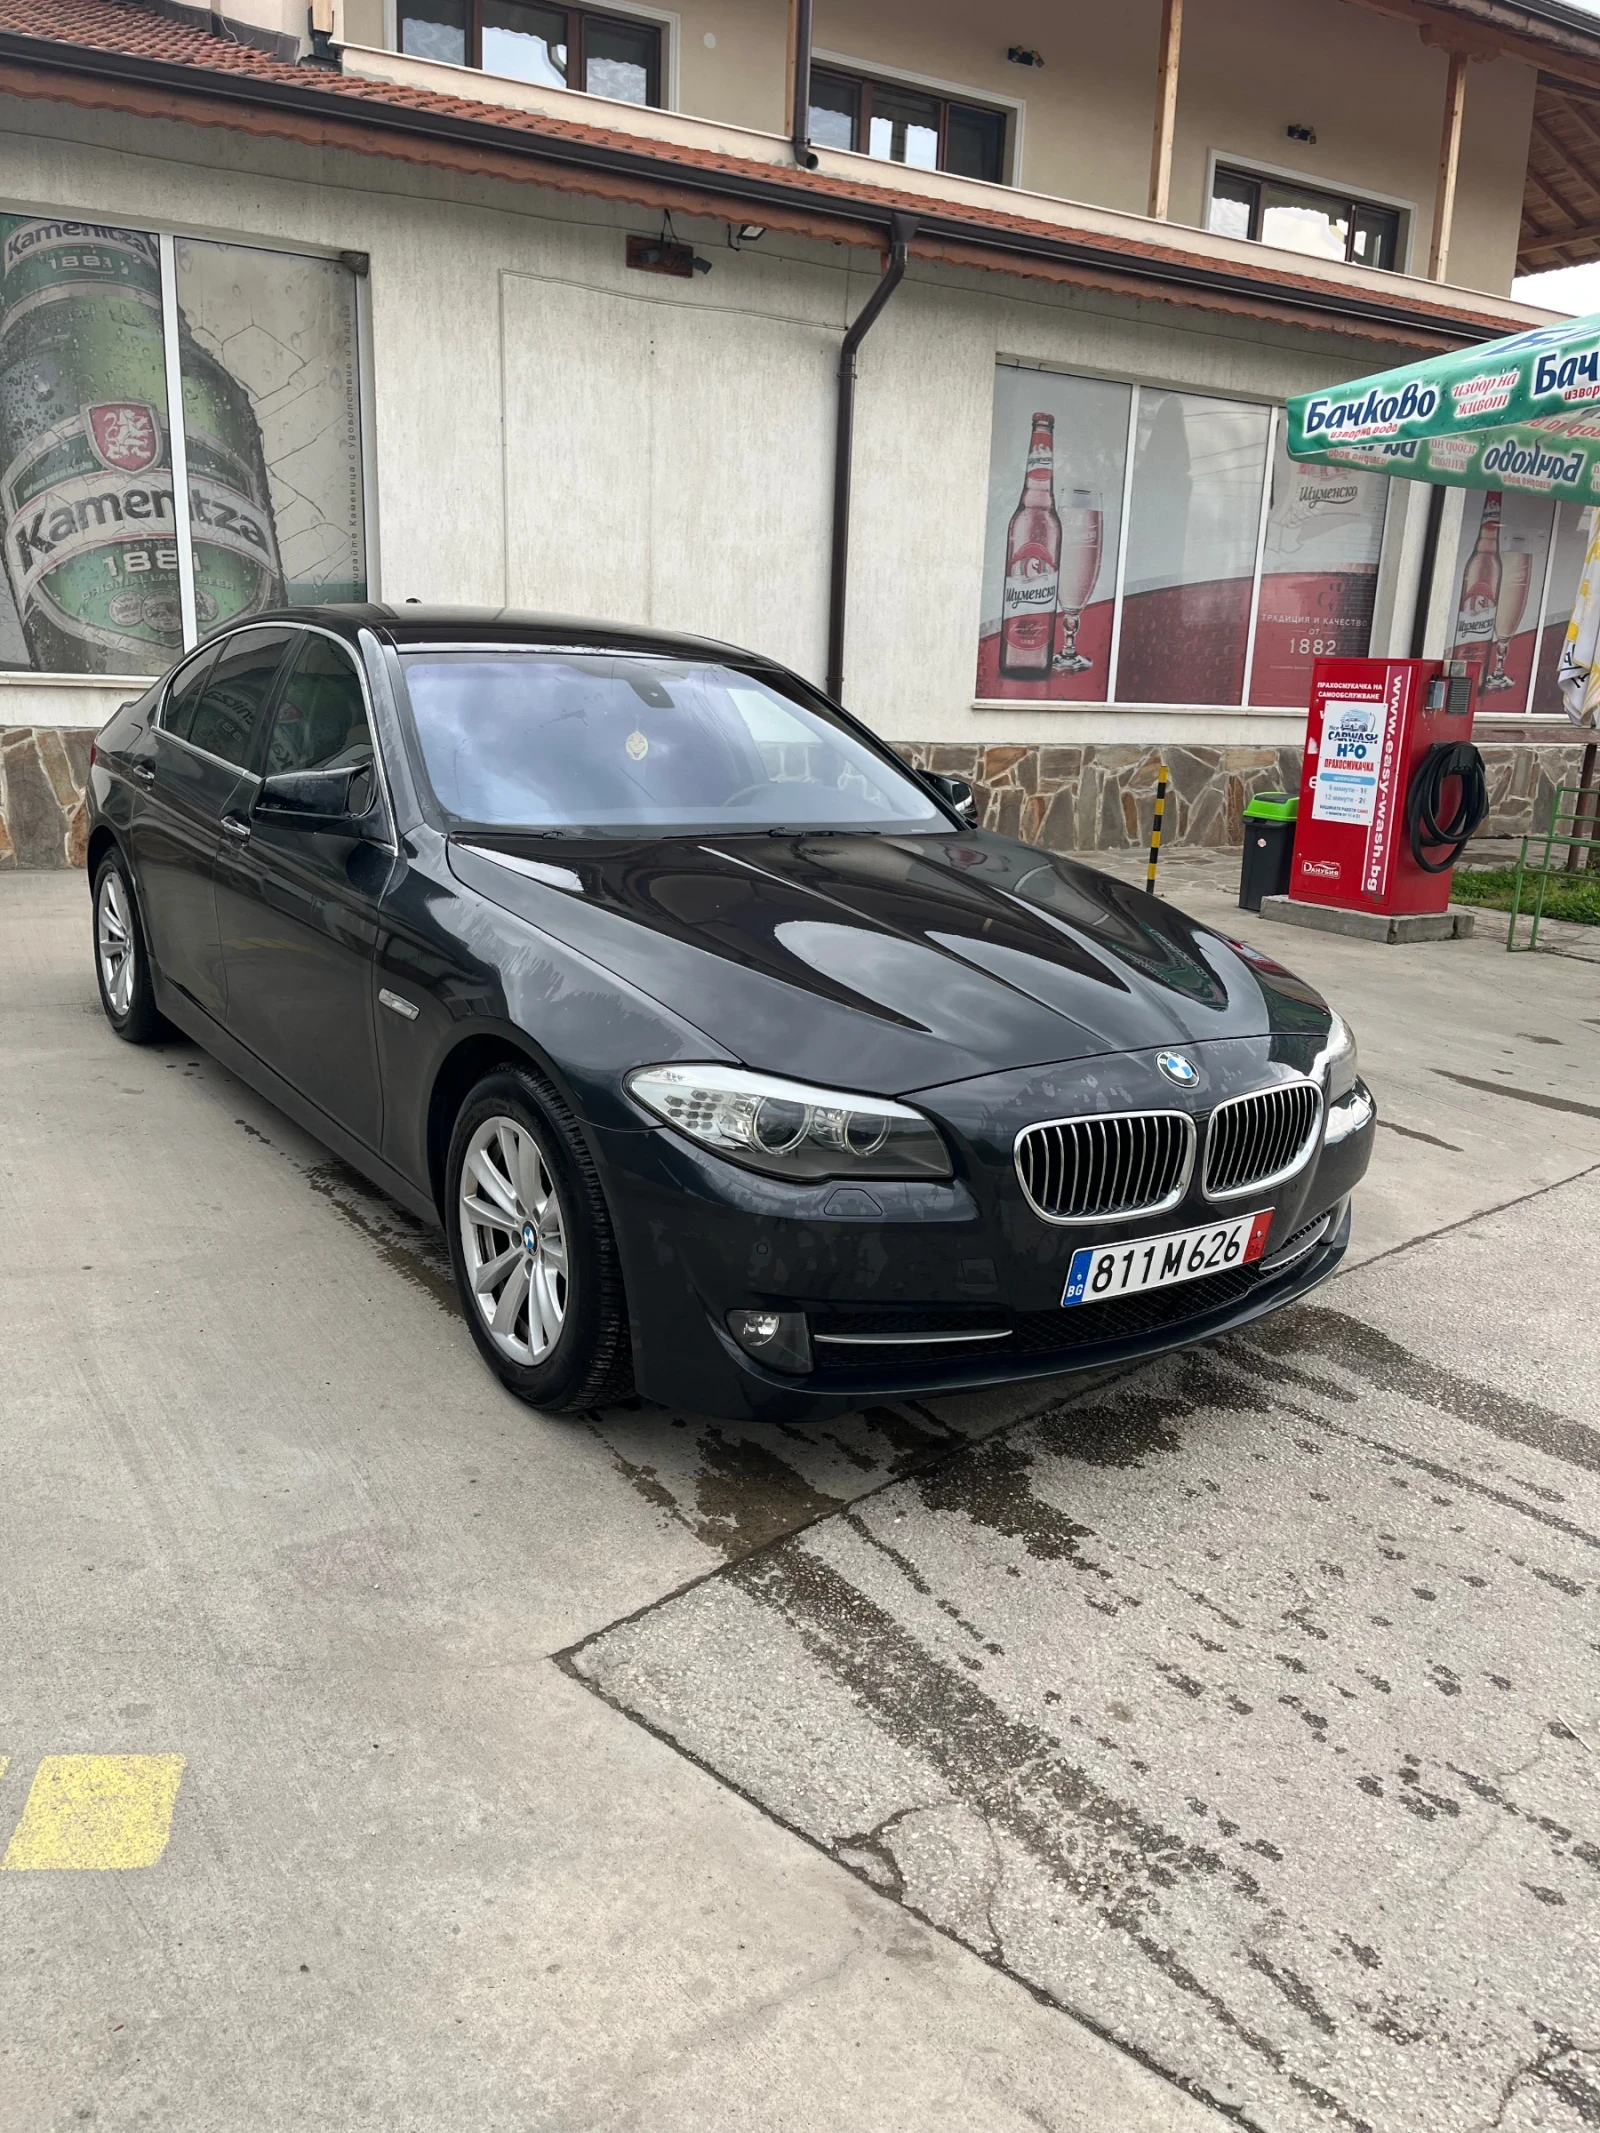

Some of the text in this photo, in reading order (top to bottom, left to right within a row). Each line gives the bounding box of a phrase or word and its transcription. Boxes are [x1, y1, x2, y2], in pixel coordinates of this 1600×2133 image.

[1452, 372, 1518, 396] избор на
[1306, 383, 1436, 434] Бачково
[1373, 422, 1398, 433] вода
[15, 489, 271, 576] Kamentza
[151, 574, 177, 583] LAG
[1261, 613, 1310, 624] ТРАДИЦИЯ
[1323, 617, 1368, 627] КАЧЕСТВО
[1290, 638, 1337, 656] 1882
[1317, 682, 1372, 690] ПРАХОСМУКАЧКА
[1318, 691, 1379, 699] САМООБСЛУЖВАНЕ
[1328, 731, 1379, 744] CARWASH
[1324, 759, 1374, 772] ПРАХОСМУКАЧКА
[1367, 675, 1402, 891] www.easy-wash.bg
[1066, 1284, 1084, 1298] BG
[1091, 1225, 1243, 1293] 811M626
